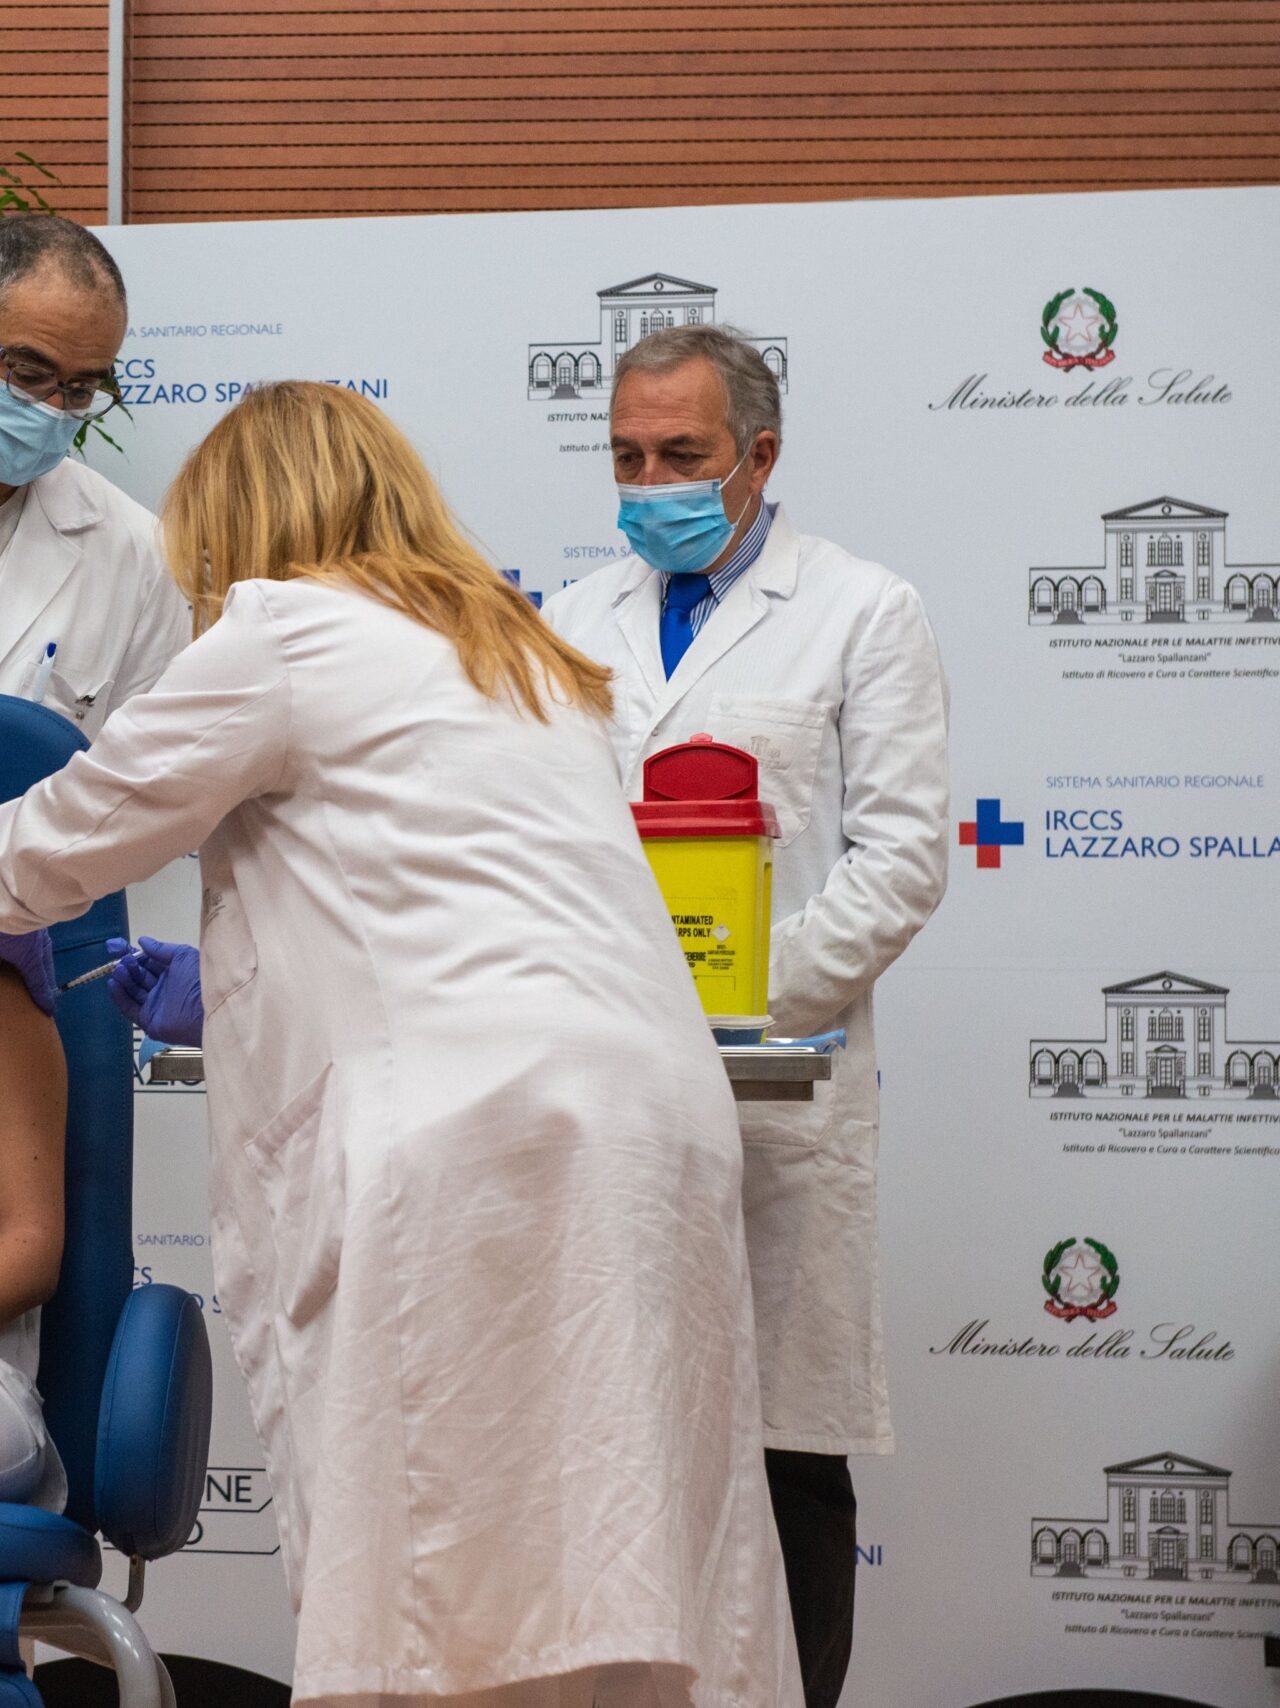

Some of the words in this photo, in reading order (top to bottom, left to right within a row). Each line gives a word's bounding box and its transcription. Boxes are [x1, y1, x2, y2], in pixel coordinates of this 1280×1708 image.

[140, 325, 207, 338] SANITARIO
[211, 323, 283, 336] REGIONALE
[120, 383, 207, 404] ZZARO
[928, 372, 1059, 411] Ministero
[1064, 376, 1134, 409] della
[1138, 367, 1233, 406] Salute
[547, 413, 588, 422] ISTITUTO
[559, 444, 590, 452] Istituto
[592, 443, 600, 452] di
[563, 546, 616, 559] SISTEMA
[1049, 638, 1092, 648] ISTITUTO
[1094, 638, 1149, 648] NAZIONALE
[1151, 638, 1169, 647] PER
[1172, 638, 1182, 647] LE
[1185, 637, 1233, 647] MALATTIE
[1062, 670, 1094, 679] Istituto
[1096, 670, 1105, 678] di
[1107, 670, 1146, 678] Ricovero
[1156, 669, 1177, 678] Cura
[1188, 669, 1231, 678] Carattere
[1046, 776, 1102, 789] SISTEMA
[1106, 775, 1180, 788] SANITARIO
[1184, 775, 1264, 788] REGIONALE
[1046, 810, 1123, 831] IRCCS
[1046, 836, 1180, 858] LAZZARO
[671, 915, 714, 925] NTAMINATED
[693, 928, 711, 937] ONLY
[1050, 1112, 1093, 1121] ISTITUTO
[1095, 1112, 1149, 1121] NAZIONALE
[1152, 1113, 1170, 1121] PER
[1172, 1113, 1183, 1122] LE
[1186, 1113, 1233, 1122] MALATTIE
[1063, 1144, 1095, 1153] Istituto
[1097, 1144, 1106, 1153] di
[1108, 1144, 1146, 1153] Ricovero
[1157, 1145, 1178, 1154] Cura
[1189, 1145, 1232, 1154] Carattere
[137, 1234, 205, 1246] SANITARIO
[929, 1318, 1061, 1357] Ministero
[1066, 1329, 1135, 1359] della
[1140, 1322, 1235, 1361] Salute
[1051, 1591, 1095, 1601] ISTITUTO
[1096, 1593, 1152, 1603] NAZIONALE
[1154, 1594, 1173, 1604] PER
[1175, 1596, 1186, 1605] LE
[1188, 1596, 1236, 1606] MALATTIE
